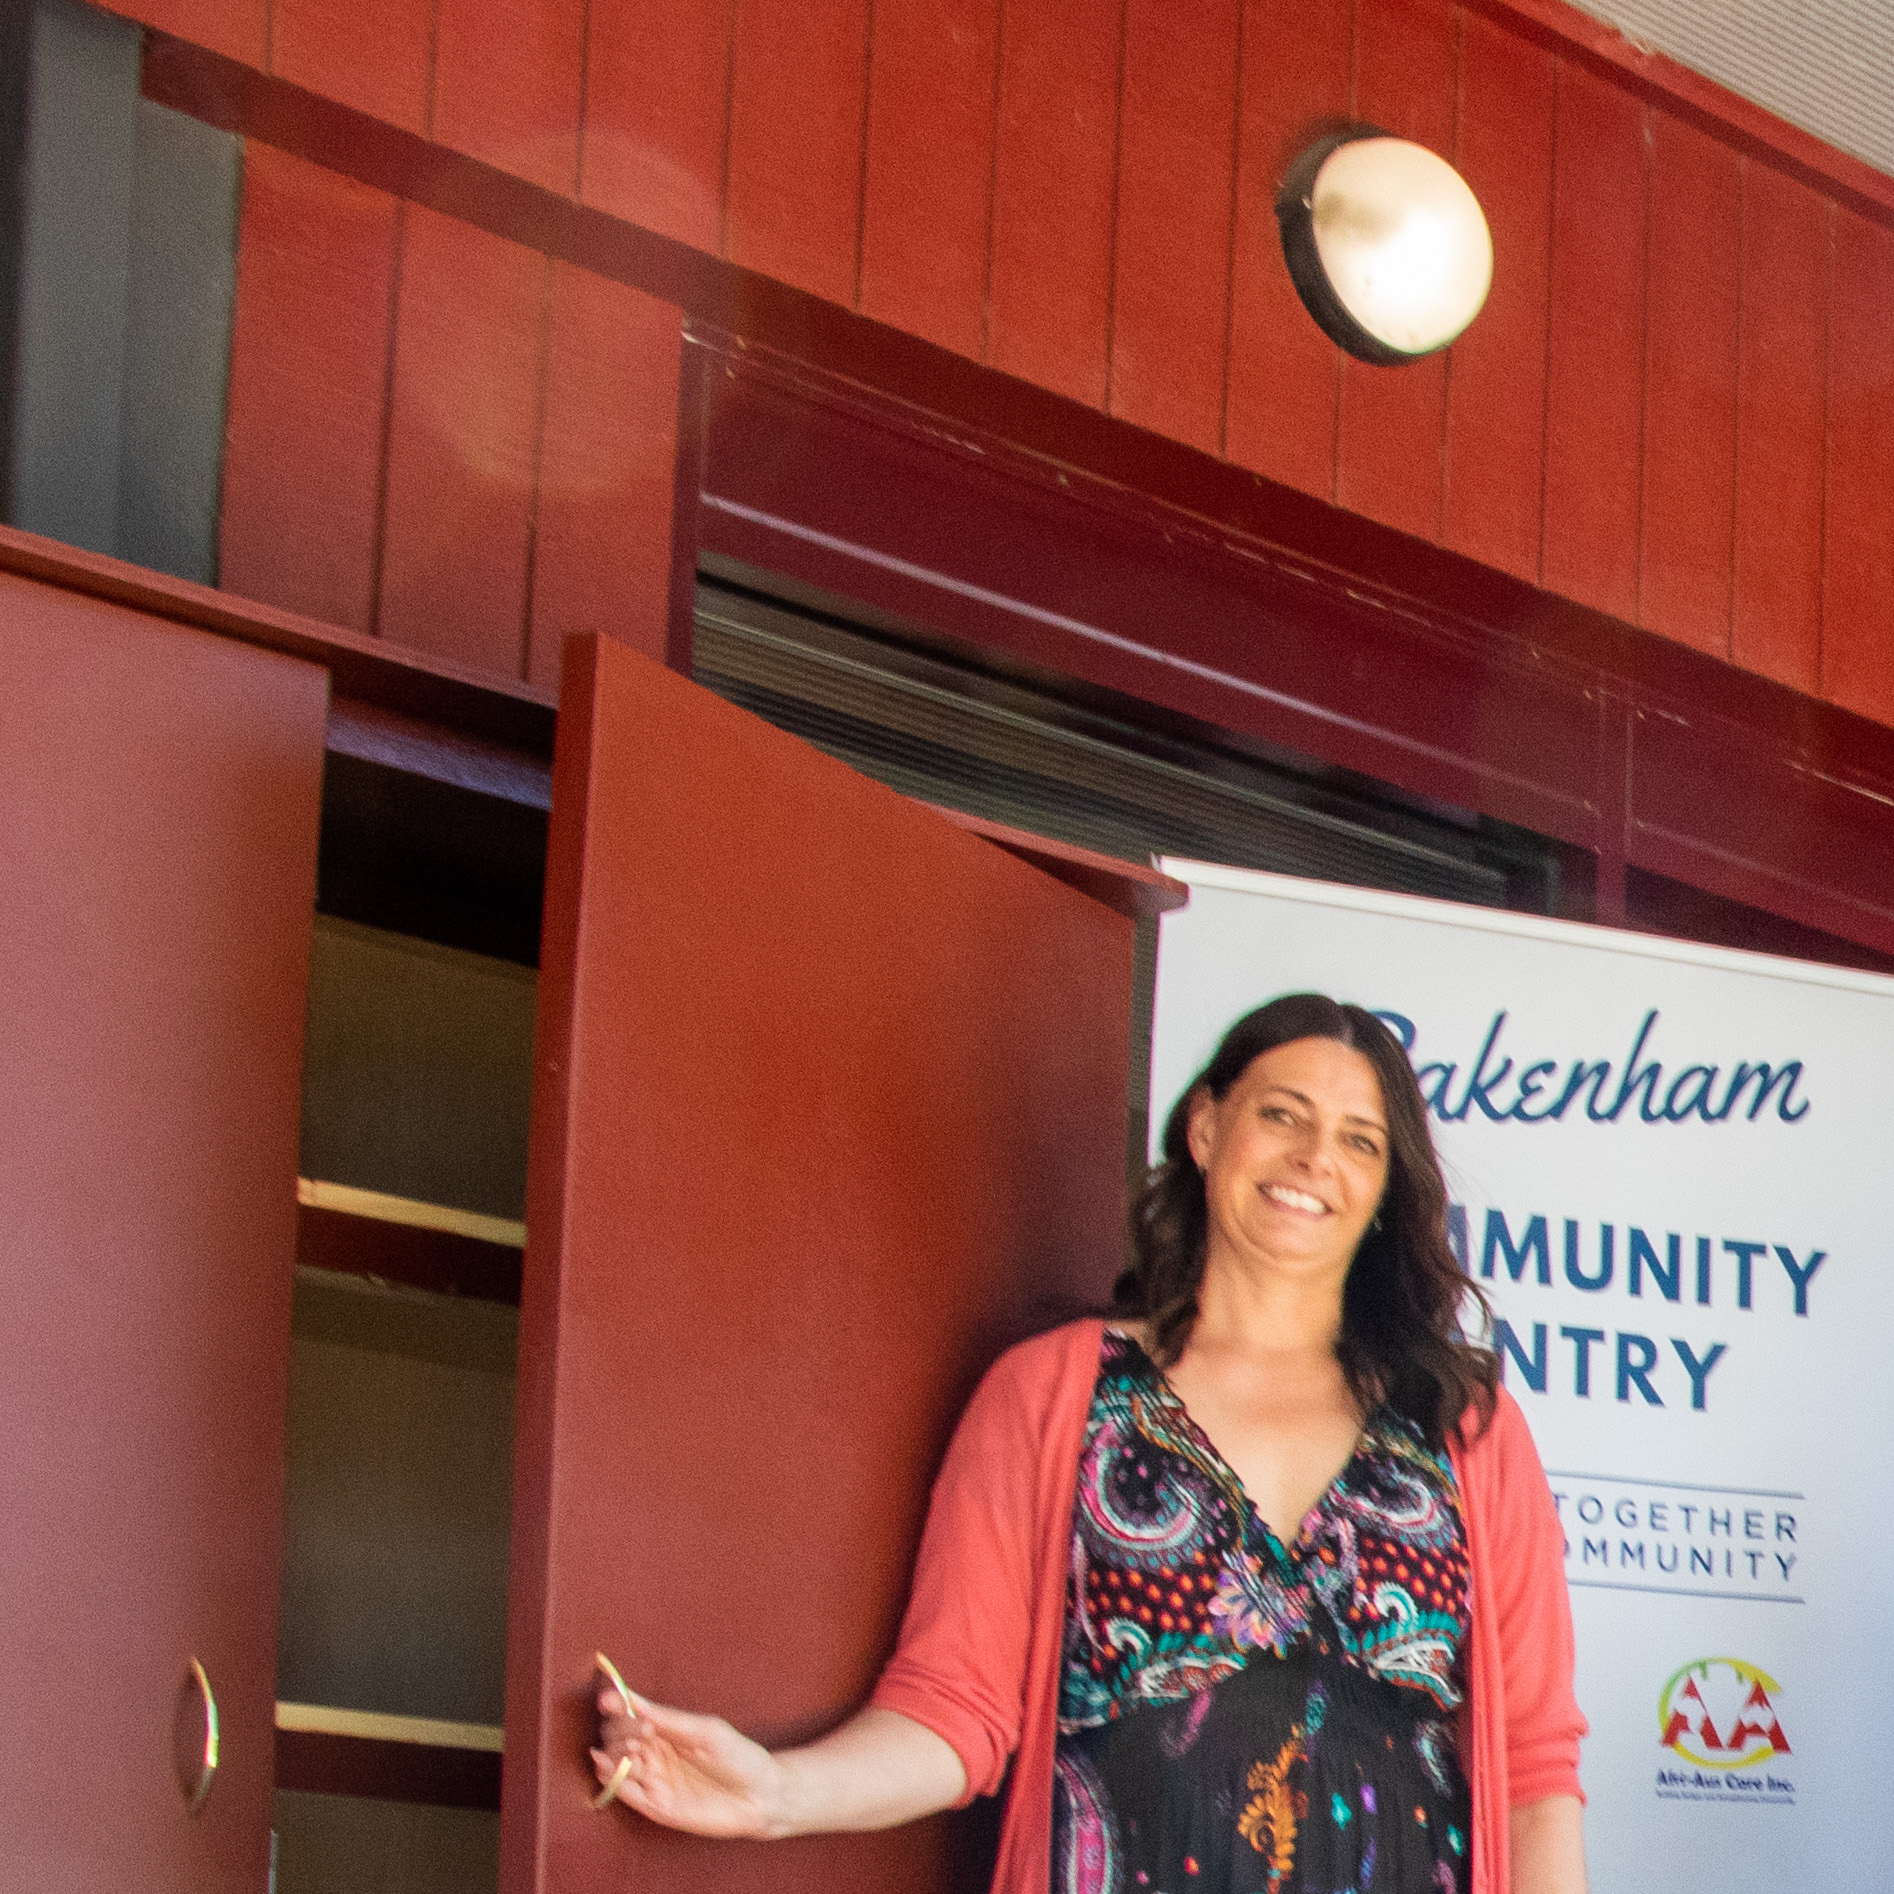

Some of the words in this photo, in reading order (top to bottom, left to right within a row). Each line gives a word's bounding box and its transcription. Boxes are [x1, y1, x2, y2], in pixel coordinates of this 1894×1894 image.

[1446, 1202, 1828, 1318] MUNITY
[1492, 1315, 1728, 1412] NTRY
[1563, 1534, 1798, 1582] MMUNITY
